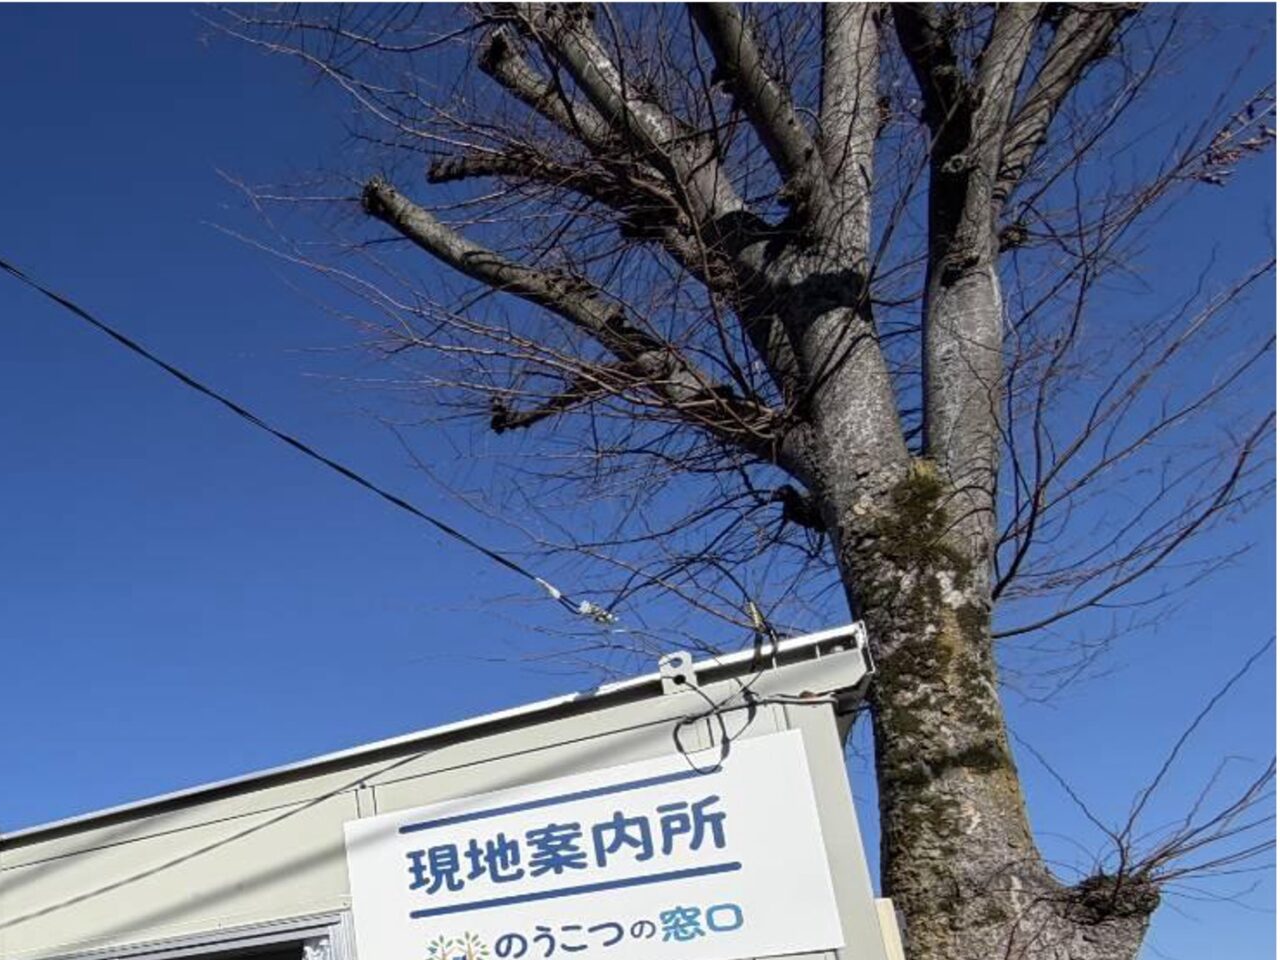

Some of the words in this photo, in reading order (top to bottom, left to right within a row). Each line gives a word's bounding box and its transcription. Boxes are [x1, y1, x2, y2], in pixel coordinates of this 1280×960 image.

[406, 794, 727, 894] 現地案内所
[494, 903, 744, 958] のうこつの窓口
